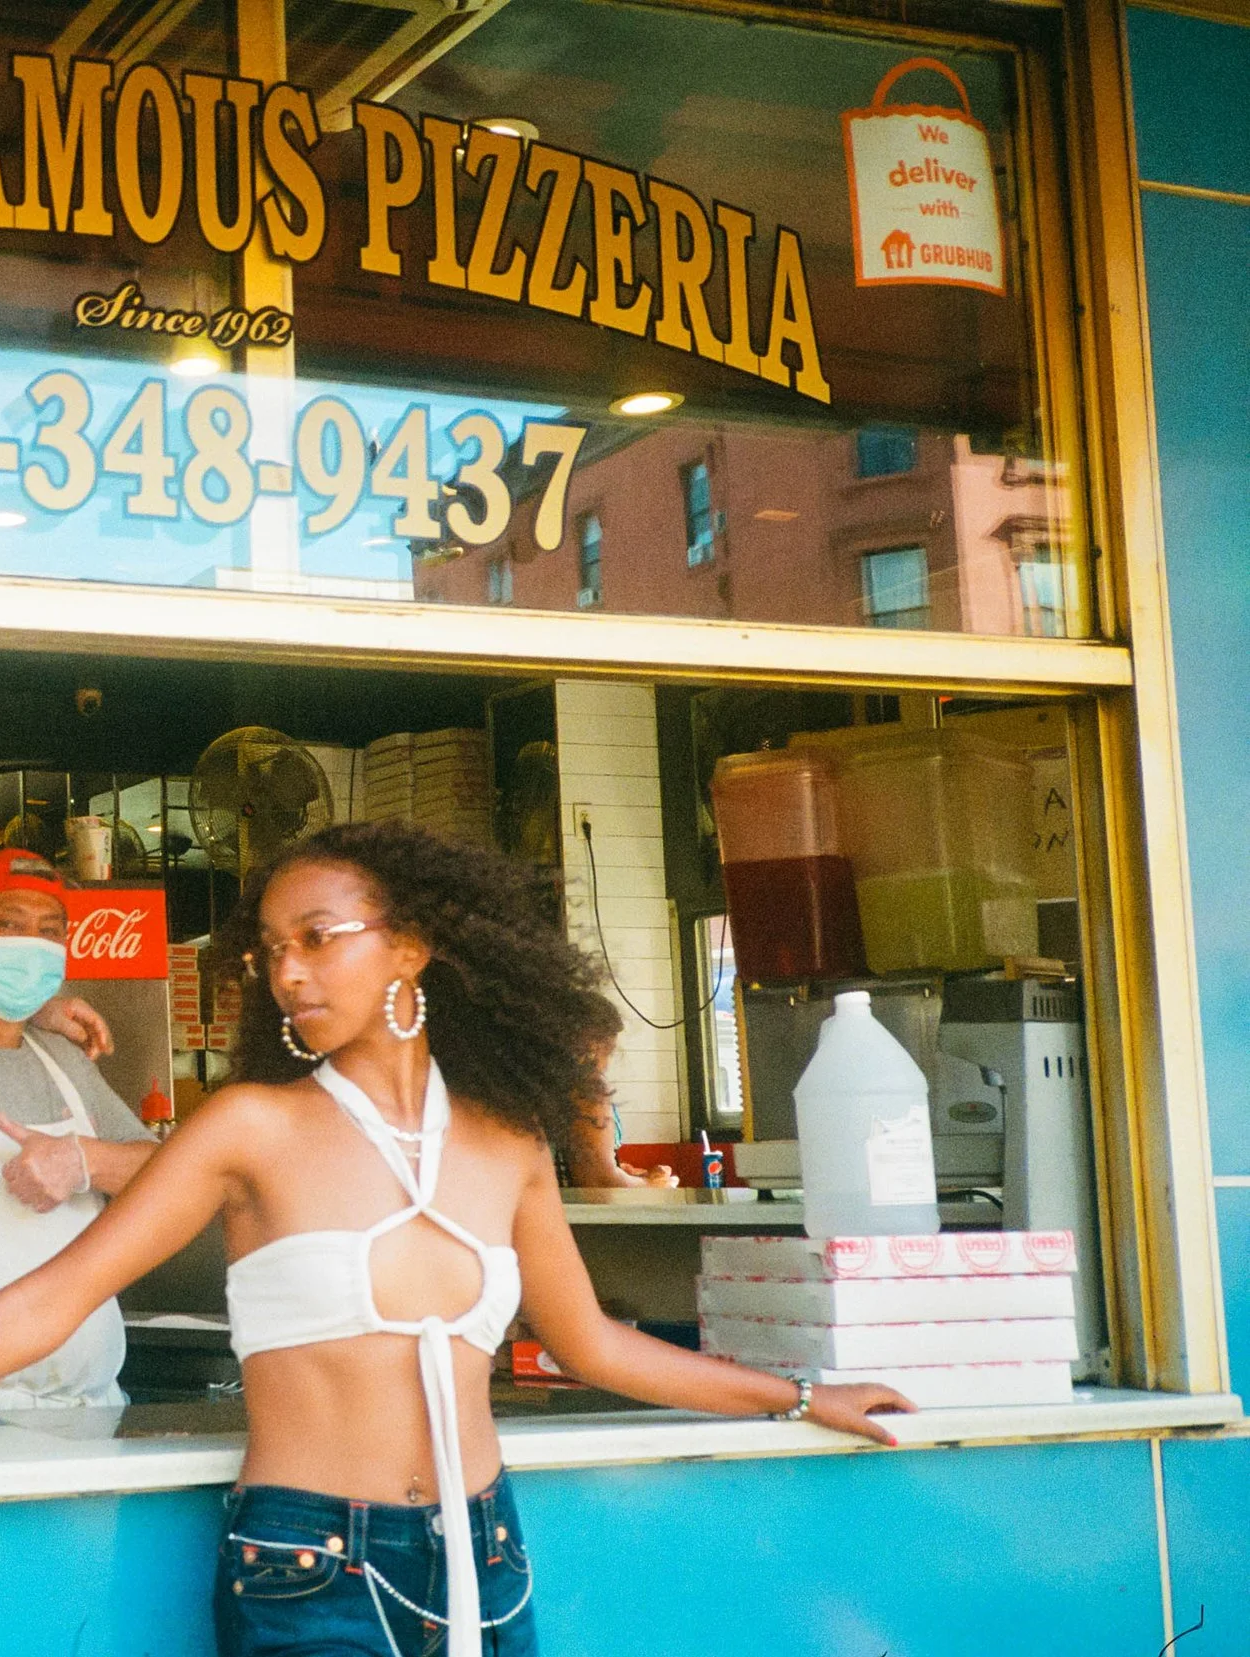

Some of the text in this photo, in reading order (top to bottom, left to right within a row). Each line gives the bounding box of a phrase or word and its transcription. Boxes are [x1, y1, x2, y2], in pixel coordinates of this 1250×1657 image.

[917, 123, 950, 145] We
[888, 157, 978, 193] deliver
[919, 199, 961, 219] with
[356, 101, 833, 404] PIZZERIA
[920, 243, 993, 273] GRUBHUB
[76, 284, 293, 348] Since 1962
